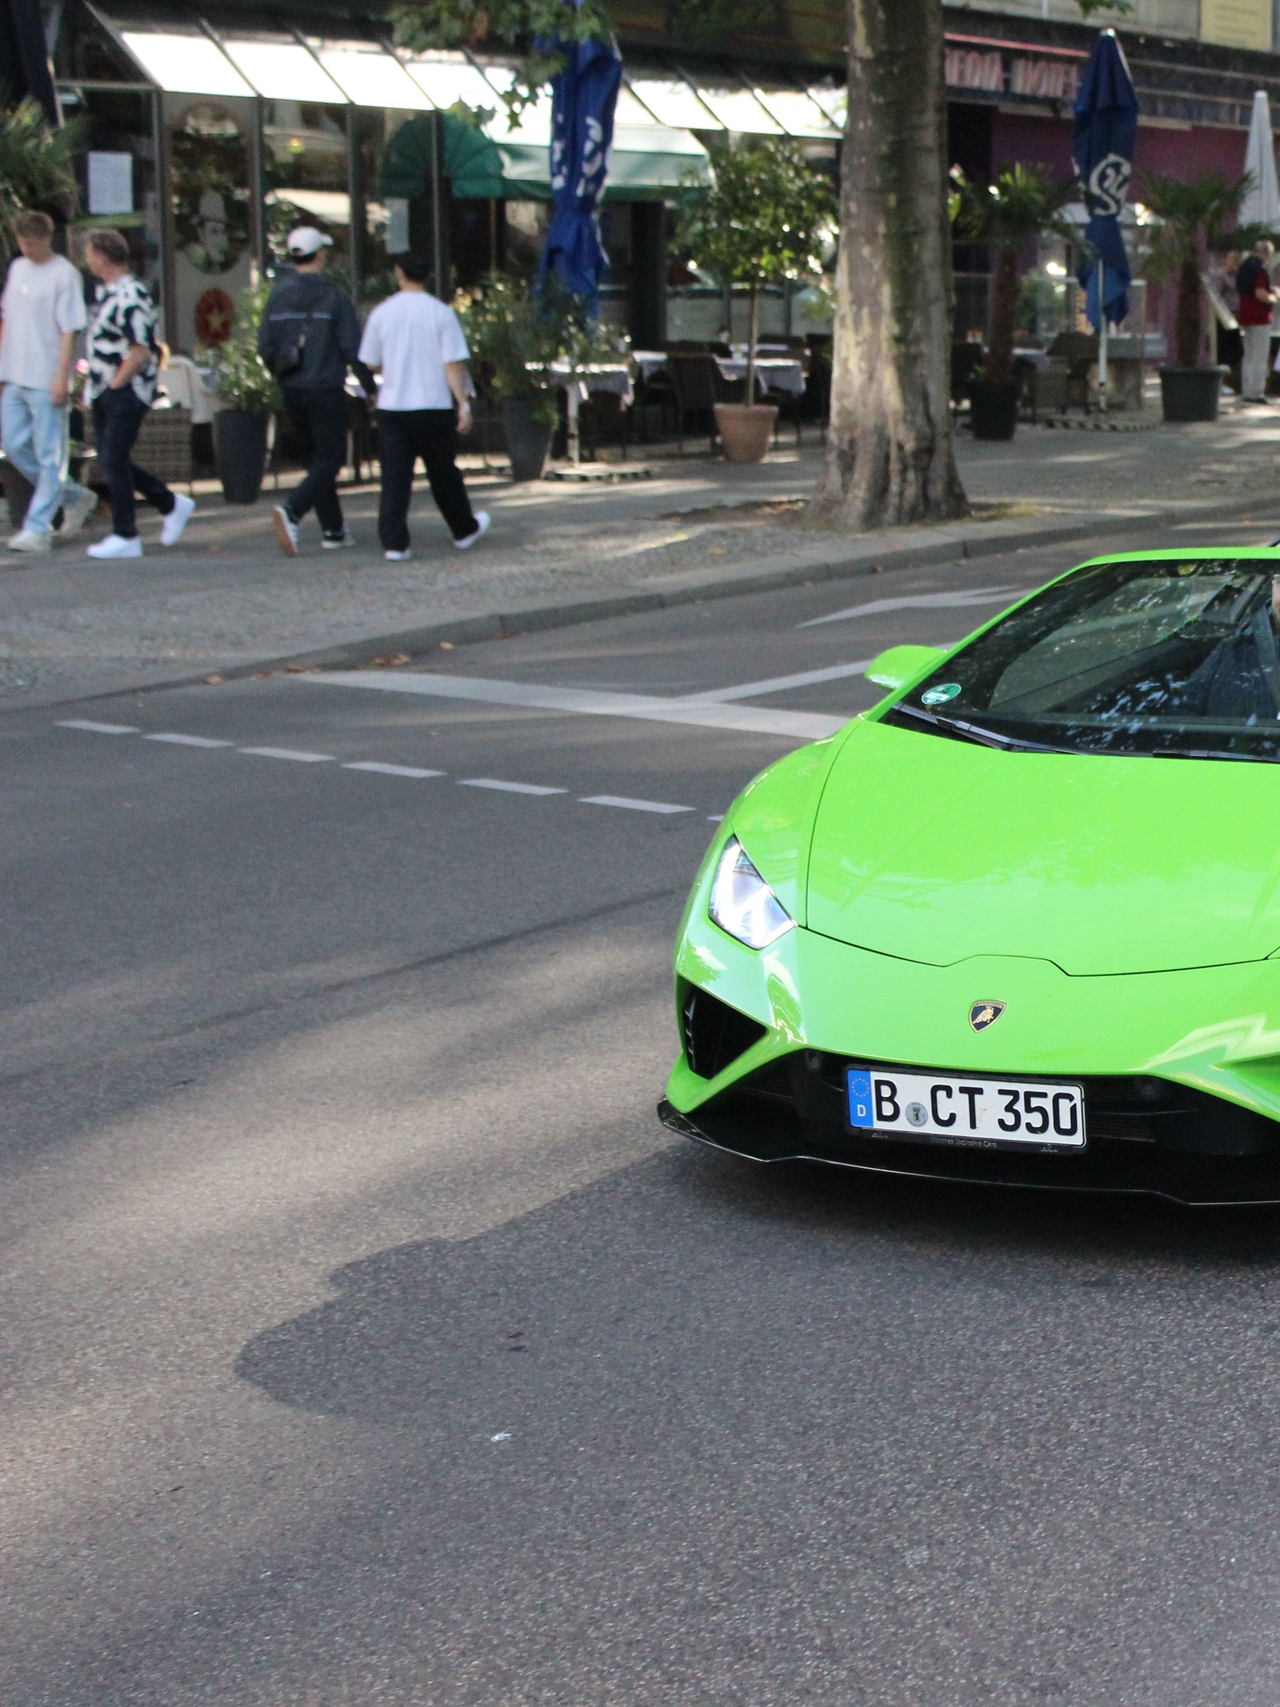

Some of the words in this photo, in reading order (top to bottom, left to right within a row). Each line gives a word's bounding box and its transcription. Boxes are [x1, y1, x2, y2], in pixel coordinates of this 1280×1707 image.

[857, 1104, 867, 1117] D
[874, 1079, 901, 1122] B
[930, 1084, 984, 1130] CT
[997, 1088, 1079, 1136] 350
